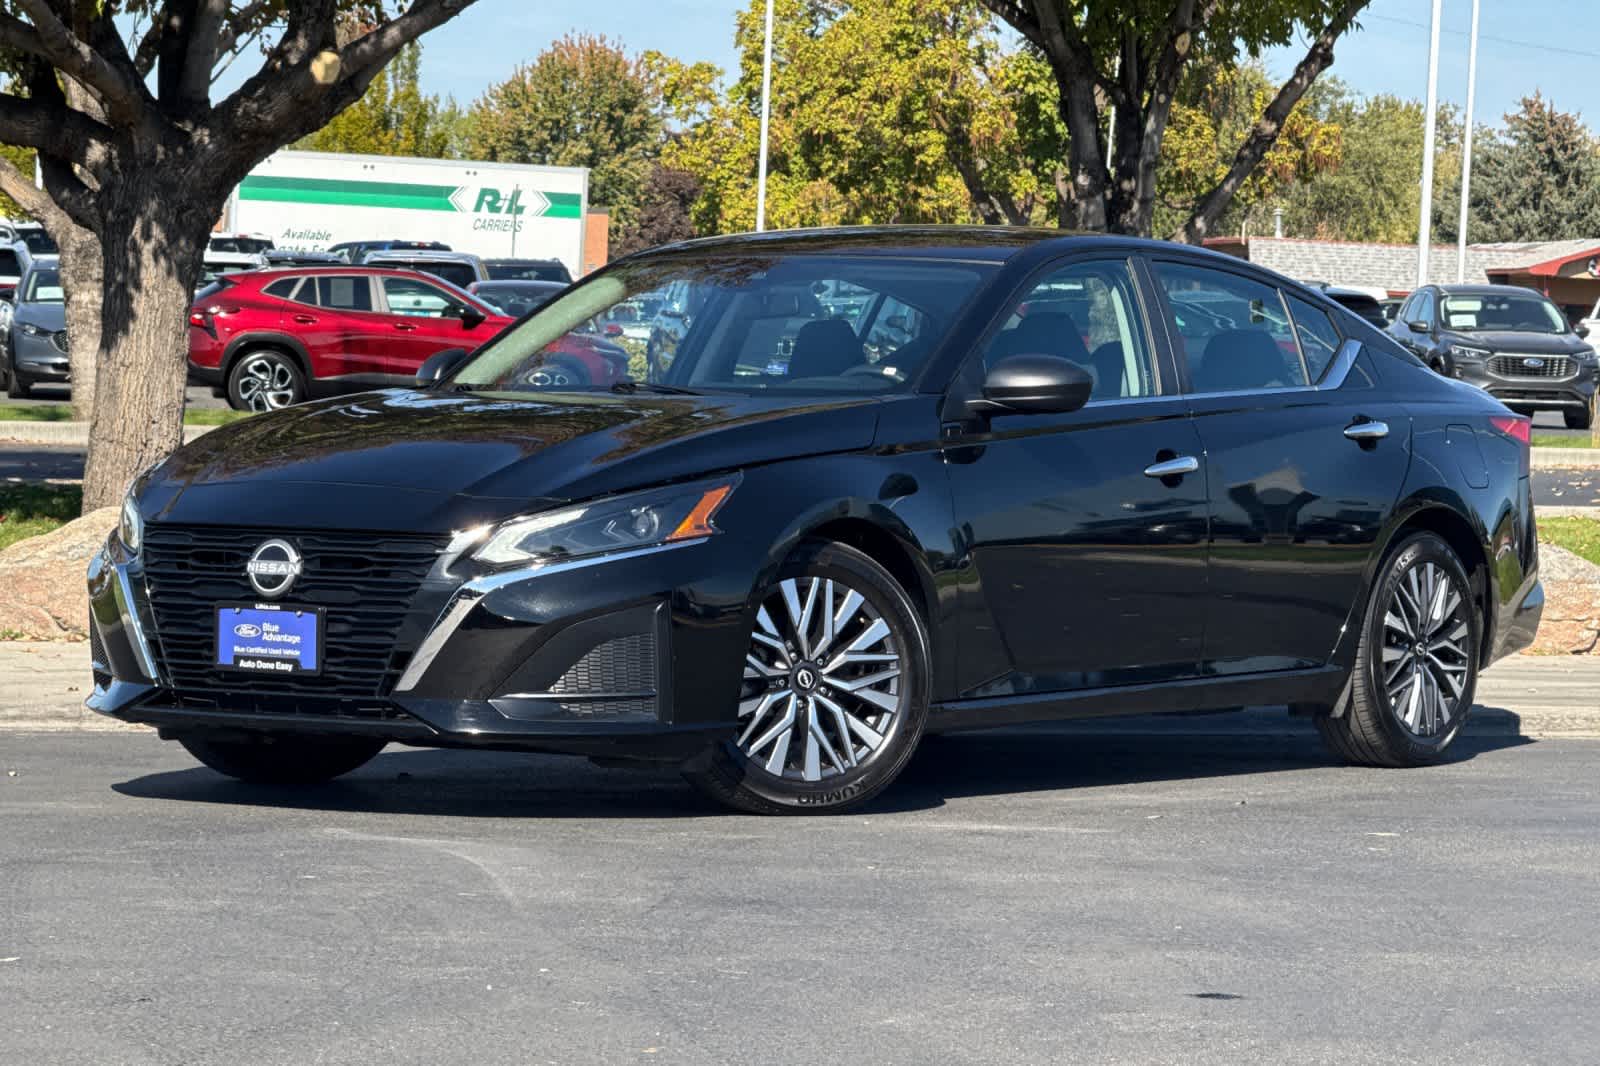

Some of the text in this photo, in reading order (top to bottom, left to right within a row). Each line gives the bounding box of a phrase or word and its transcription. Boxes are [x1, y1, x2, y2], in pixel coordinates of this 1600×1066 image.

[281, 228, 332, 240] Available
[247, 562, 301, 575] NISSAN
[262, 623, 279, 632] Blue
[262, 632, 300, 644] Advantage
[239, 660, 293, 672] Auto Done Easy
[798, 780, 867, 804] KUMHO
